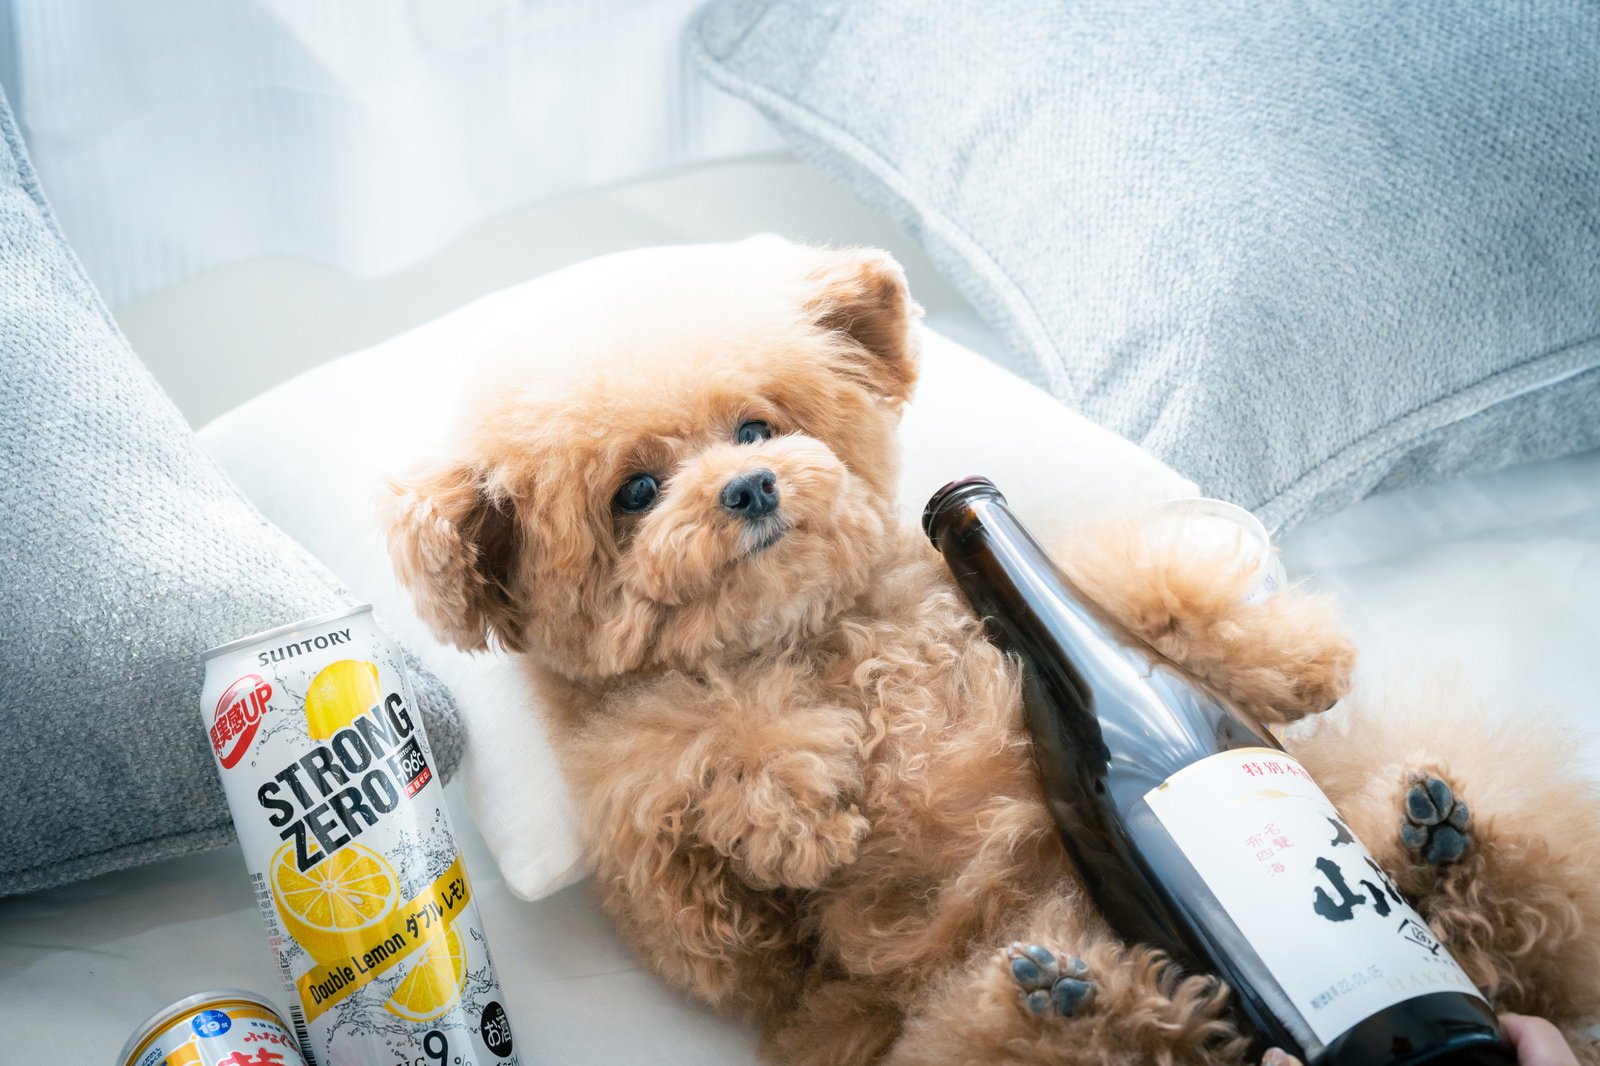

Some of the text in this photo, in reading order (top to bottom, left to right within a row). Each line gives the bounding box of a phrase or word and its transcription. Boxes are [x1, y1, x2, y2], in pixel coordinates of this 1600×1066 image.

[257, 628, 352, 667] SUNTORY
[257, 692, 415, 828] STRONG
[279, 768, 400, 873] ZERO
[309, 877, 465, 1005] Double Lemon ダブル レモン
